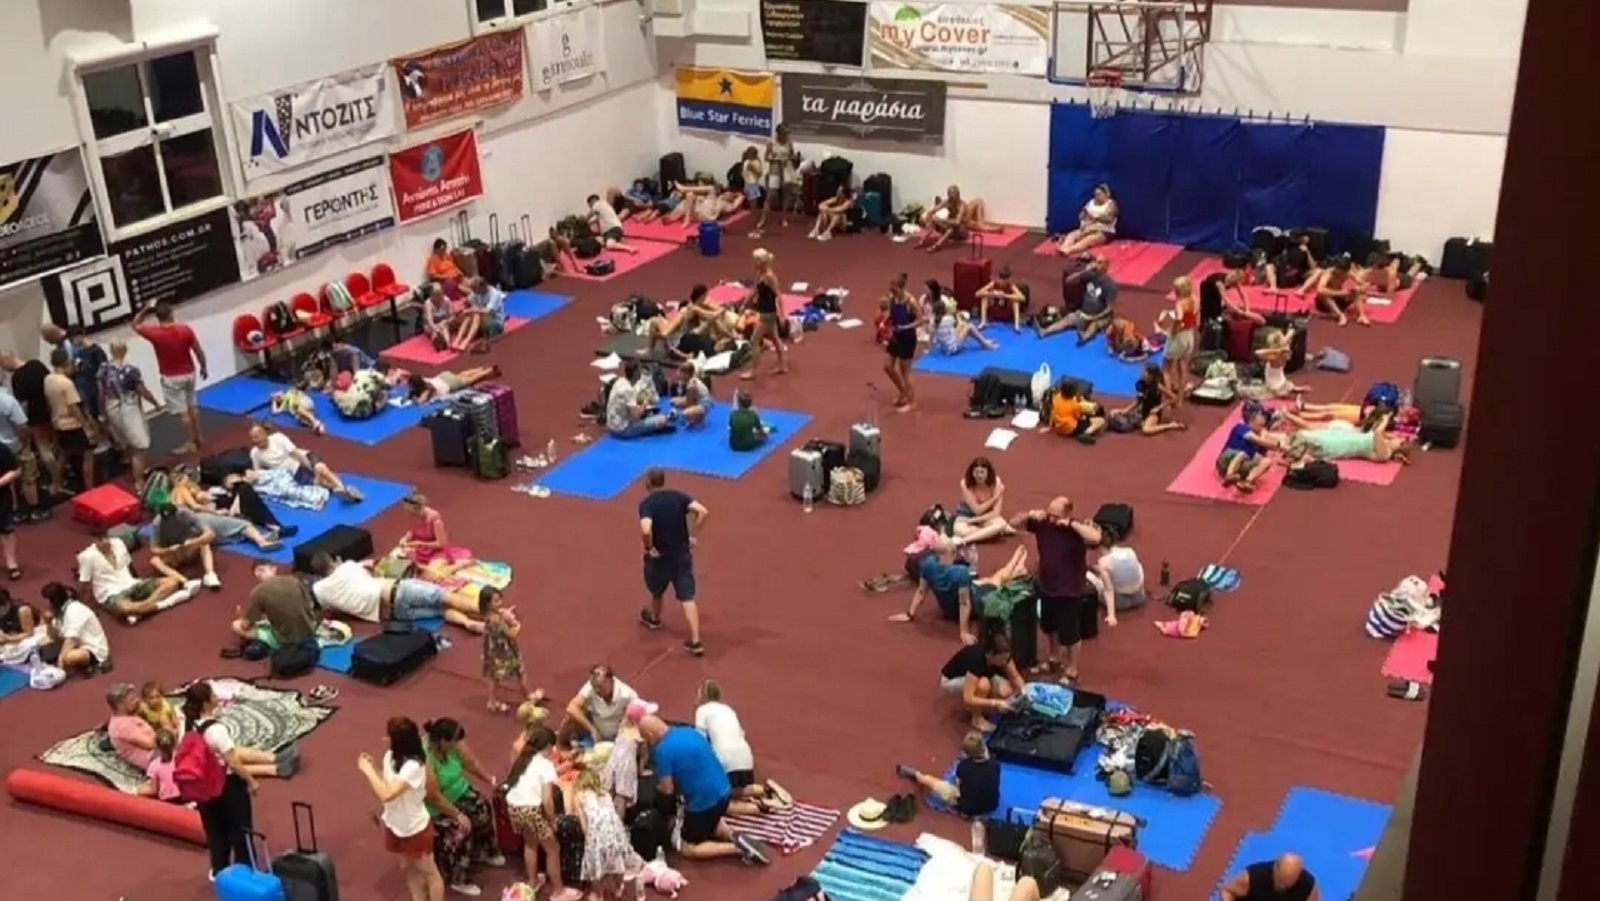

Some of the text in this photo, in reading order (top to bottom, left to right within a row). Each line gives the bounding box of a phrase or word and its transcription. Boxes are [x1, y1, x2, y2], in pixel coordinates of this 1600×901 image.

[880, 23, 915, 49] my
[920, 21, 991, 44] Cover
[295, 95, 376, 139] ΝΤΟΖΙΤΣ
[679, 105, 705, 120] Blue
[707, 109, 728, 124] Star
[731, 111, 771, 129] Ferries
[802, 94, 927, 124] τα μαράσια
[304, 183, 379, 224] ΓΕΡΟΝΤΗΣ
